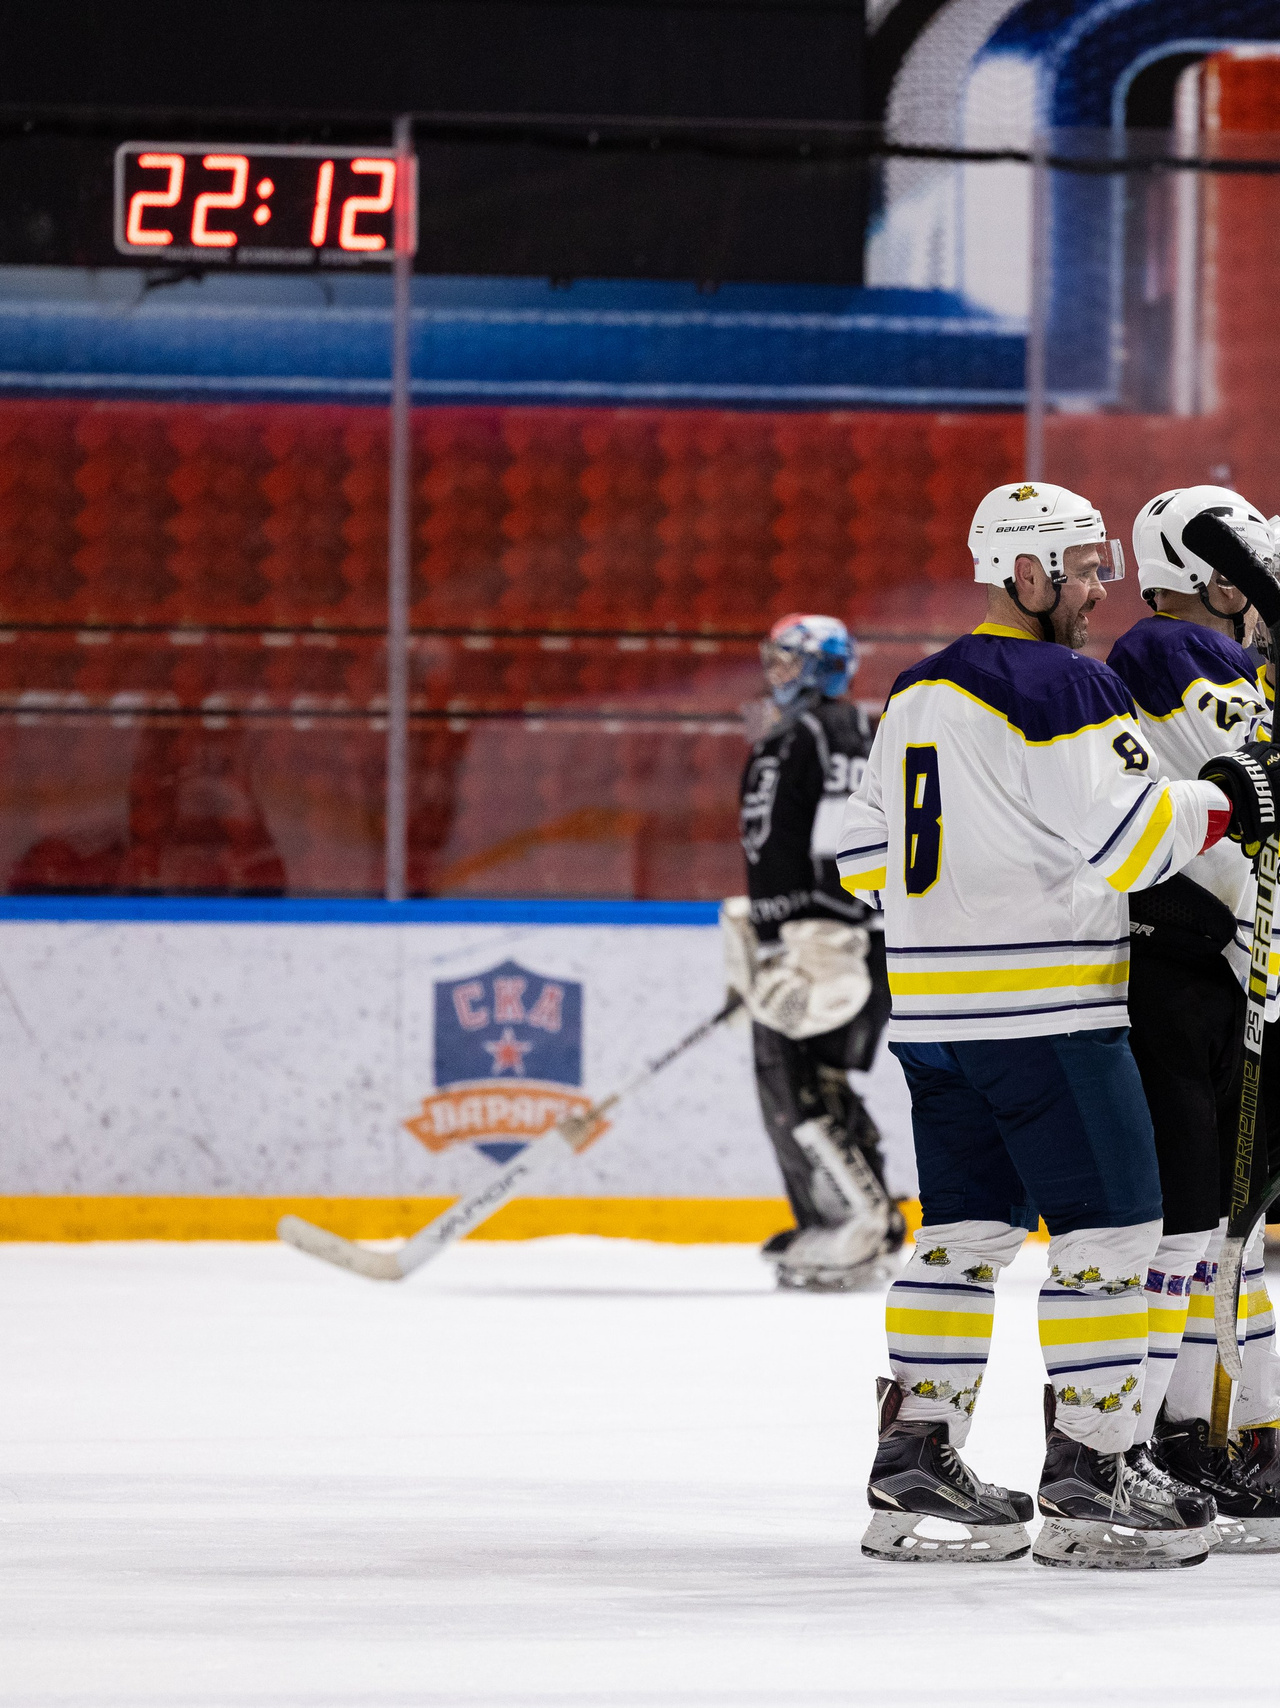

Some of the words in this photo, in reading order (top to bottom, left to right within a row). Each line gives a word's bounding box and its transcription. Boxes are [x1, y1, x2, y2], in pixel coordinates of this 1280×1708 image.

[126, 153, 397, 251] 22:12
[996, 525, 1036, 534] BAUER
[1112, 731, 1150, 771] 8
[452, 977, 565, 1034] СКА
[1200, 1477, 1240, 1498] CCM
